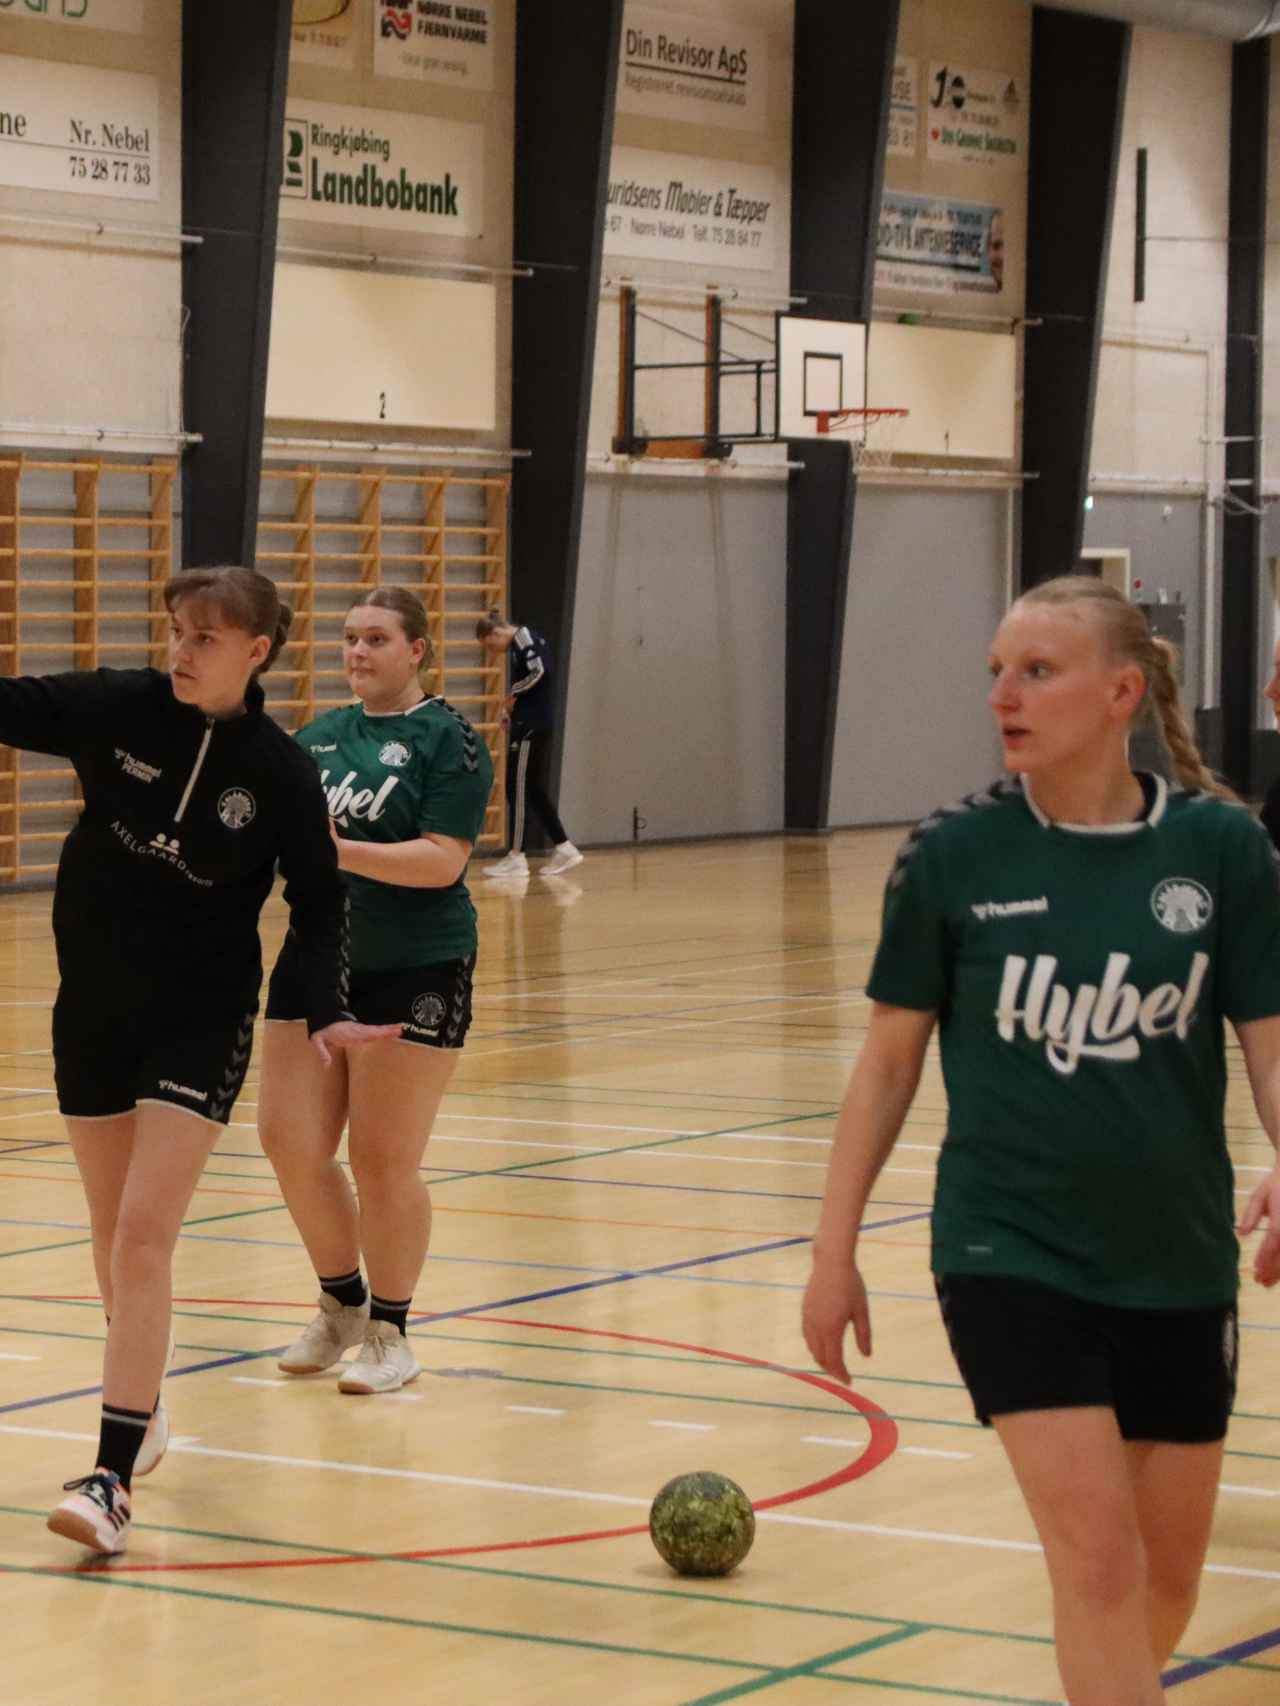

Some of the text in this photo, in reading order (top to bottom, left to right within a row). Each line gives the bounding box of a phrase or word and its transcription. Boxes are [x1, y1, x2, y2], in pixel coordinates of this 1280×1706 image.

[626, 28, 748, 80] Din Revisor ApS
[69, 119, 150, 152] Nr. Nebel
[311, 123, 391, 162] Ringkjøbing
[69, 156, 151, 186] 75 28 77 33
[310, 157, 459, 217] Landbobank
[713, 191, 724, 217] &
[726, 188, 771, 225] Tæpper
[994, 950, 1210, 1075] Hybel
